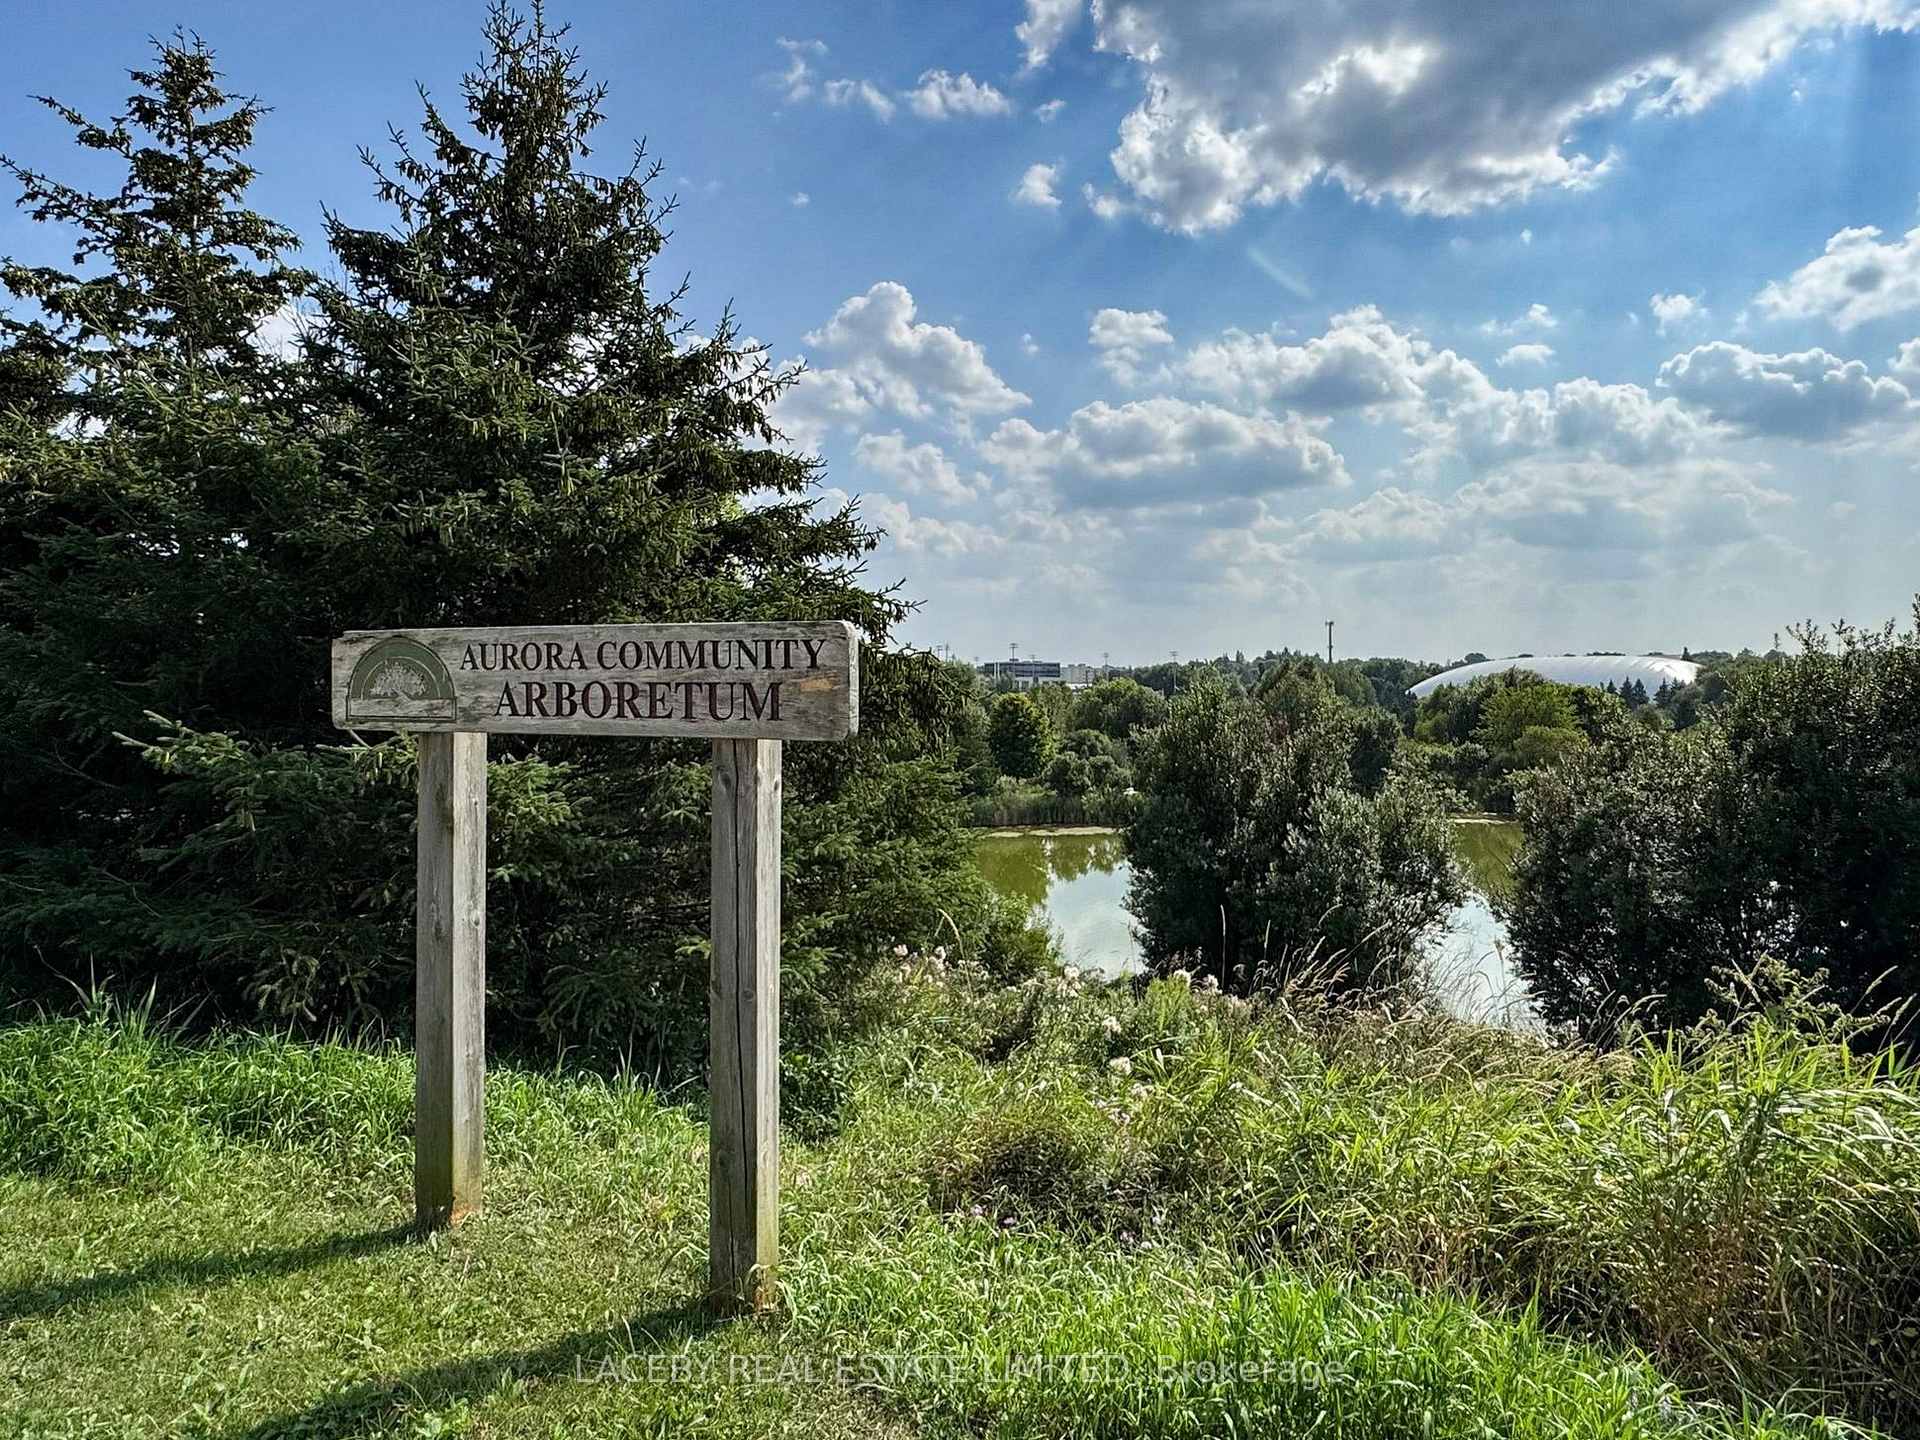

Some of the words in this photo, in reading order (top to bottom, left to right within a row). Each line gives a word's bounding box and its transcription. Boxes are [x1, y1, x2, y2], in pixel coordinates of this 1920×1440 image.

[460, 641, 586, 671] AURORA
[597, 639, 825, 669] COMMUNITY
[494, 681, 783, 720] ARBORETUM
